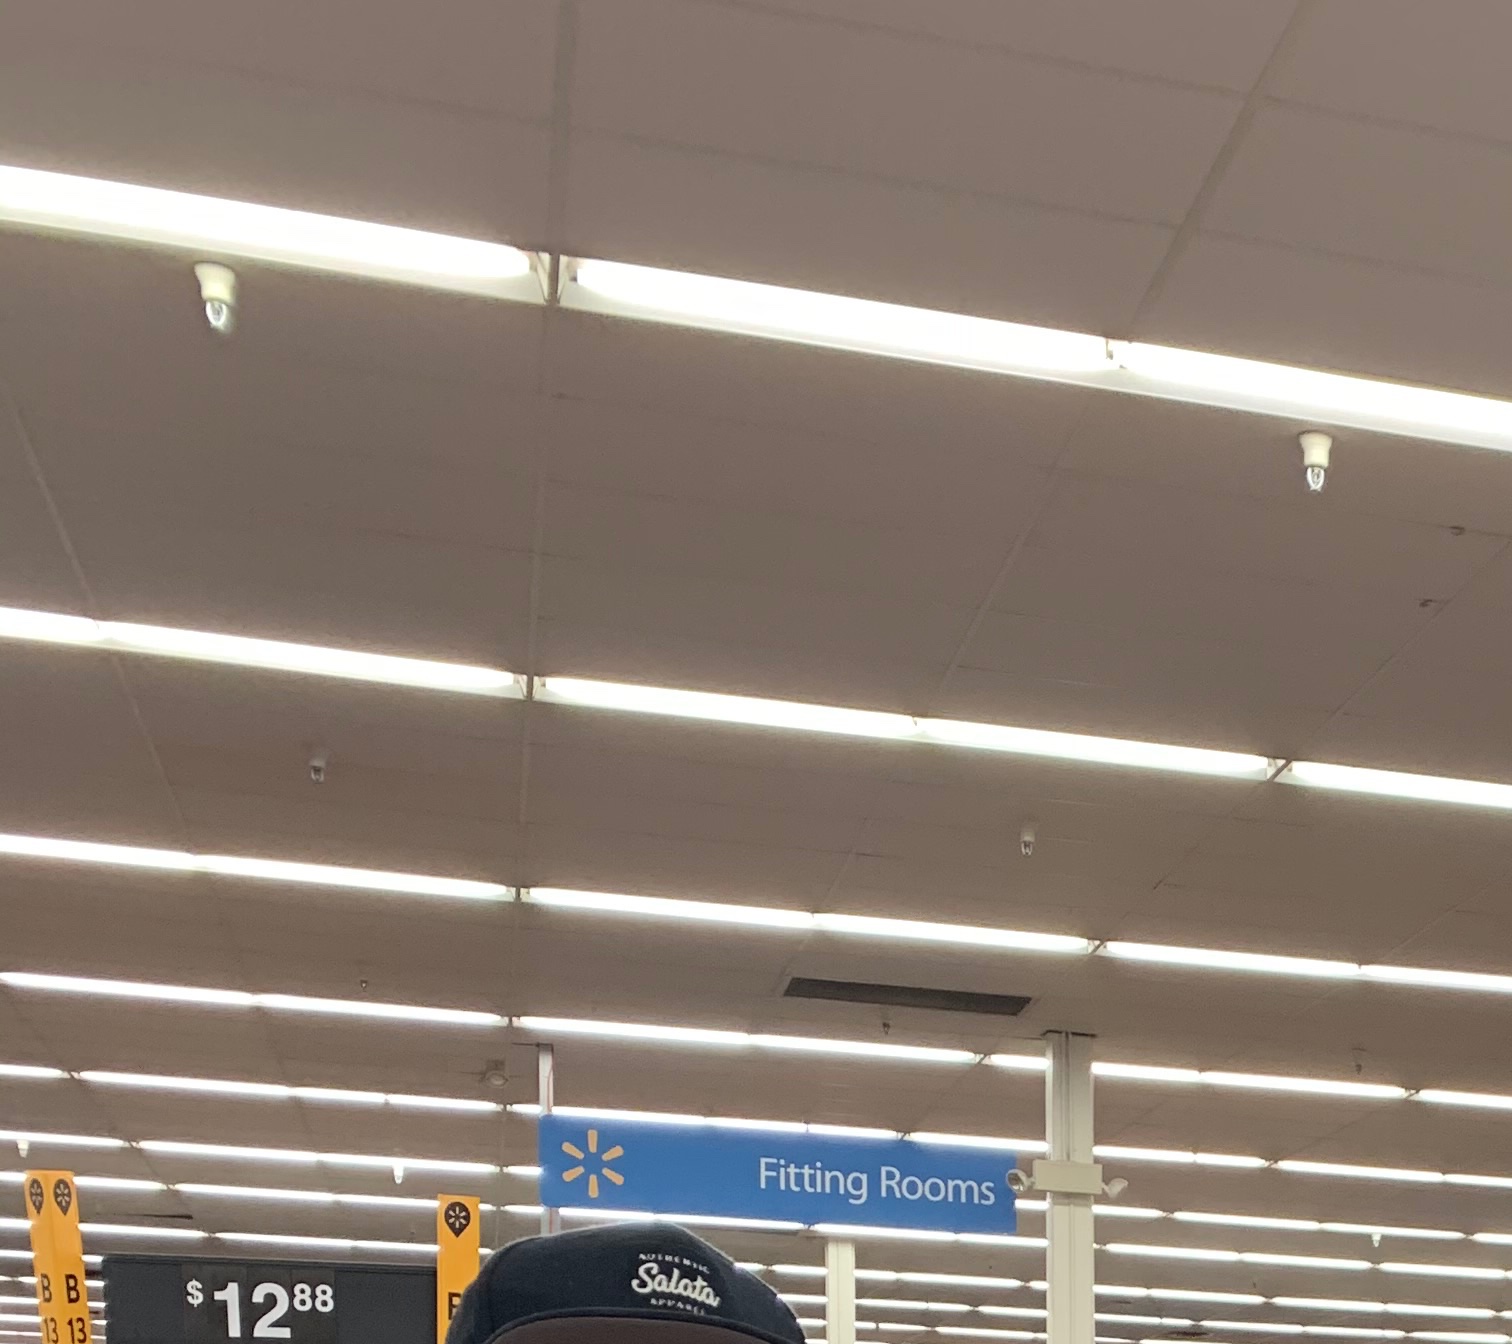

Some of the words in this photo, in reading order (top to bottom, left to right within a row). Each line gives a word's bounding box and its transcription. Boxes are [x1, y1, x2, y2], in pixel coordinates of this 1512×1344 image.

[759, 1157, 868, 1205] Fitting
[880, 1165, 996, 1206] Rooms
[40, 1273, 53, 1304] B
[64, 1273, 81, 1304] B
[631, 1262, 721, 1307] Salata
[44, 1317, 59, 1344] 13
[67, 1317, 87, 1344] 13
